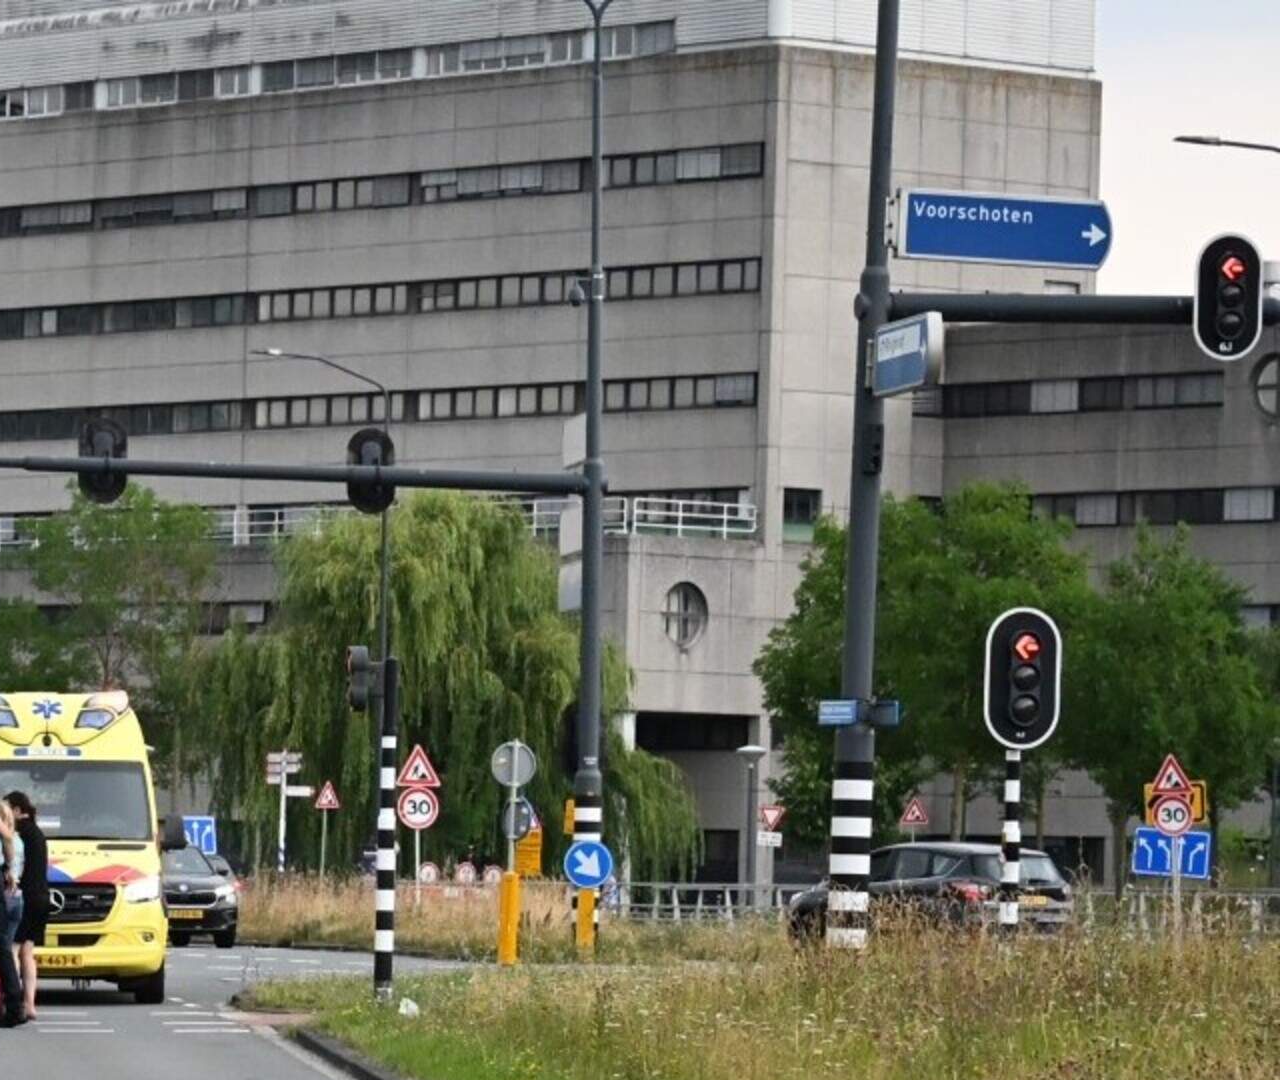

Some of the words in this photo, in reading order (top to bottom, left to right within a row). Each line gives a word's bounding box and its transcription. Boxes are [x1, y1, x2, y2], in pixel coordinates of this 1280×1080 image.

[913, 199, 1033, 223] Voorschoten
[406, 799, 432, 816] 30
[1161, 806, 1186, 824] 30
